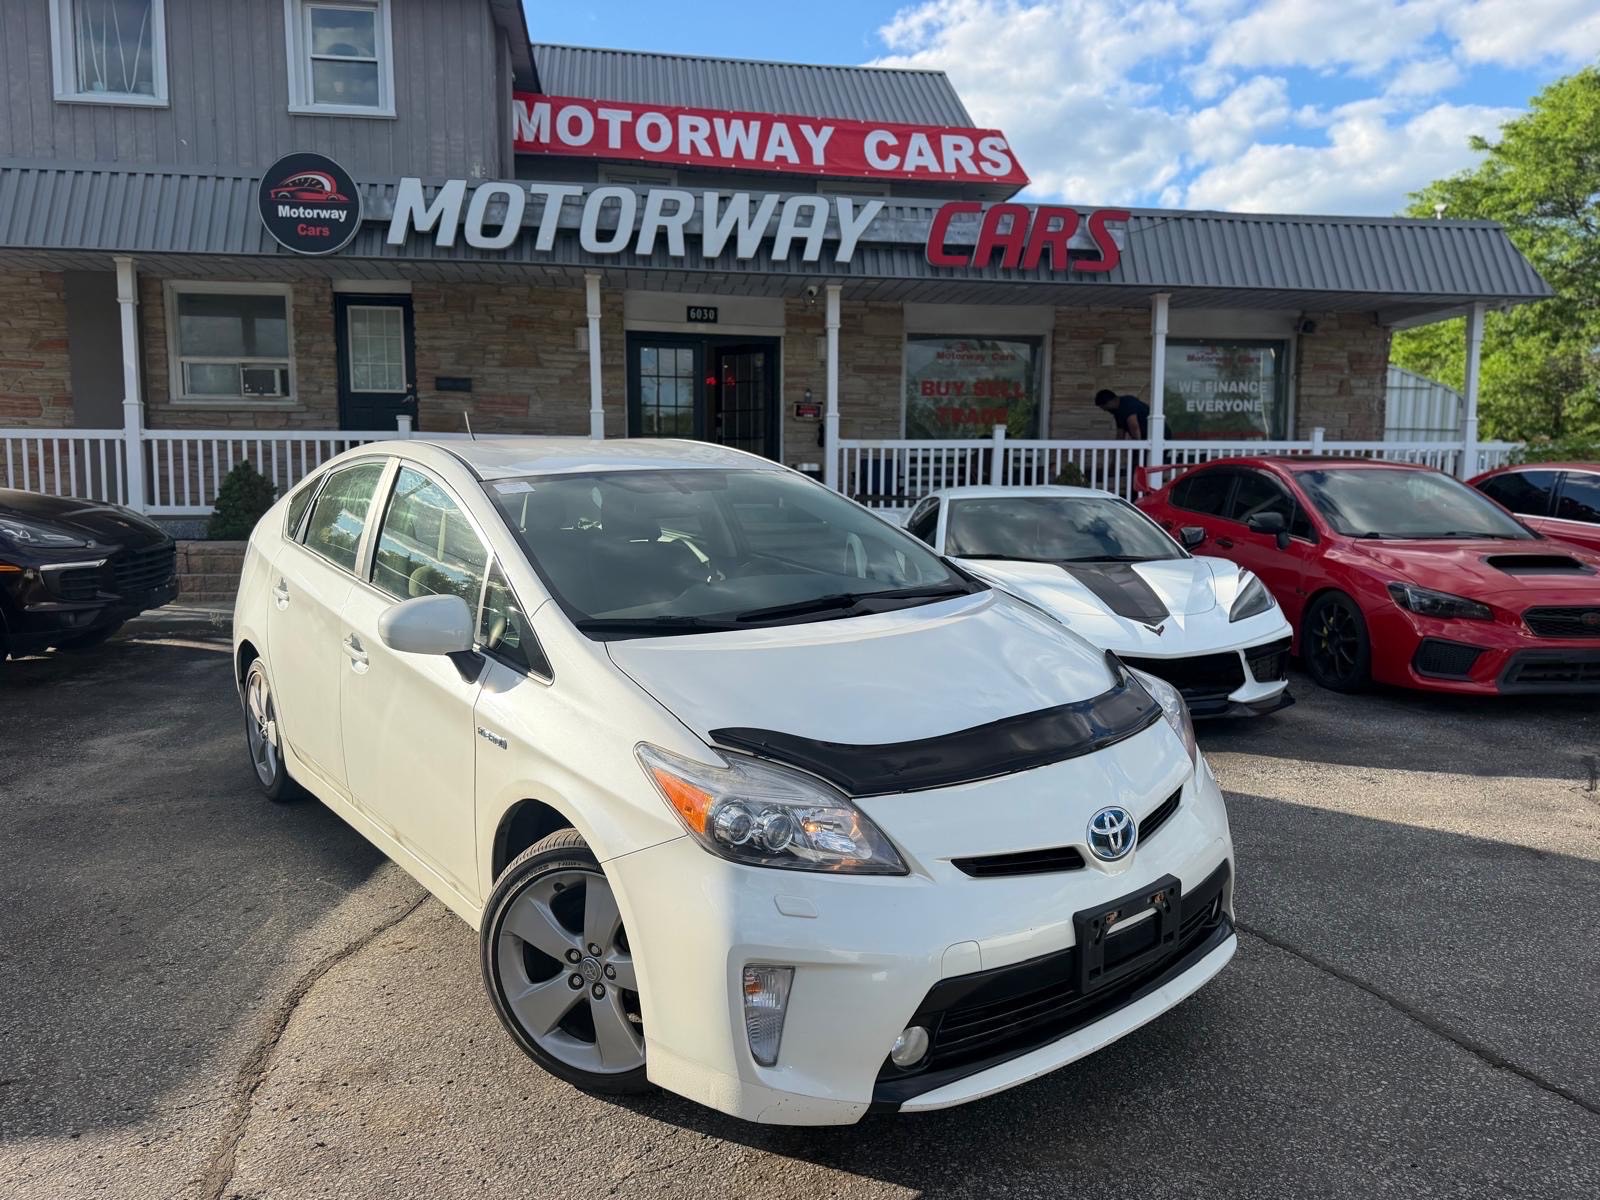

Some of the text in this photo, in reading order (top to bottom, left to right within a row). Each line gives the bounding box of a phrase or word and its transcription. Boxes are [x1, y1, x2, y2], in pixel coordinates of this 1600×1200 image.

[512, 101, 1013, 176] MOTORWAY CARS
[277, 205, 347, 222] Motorway
[297, 224, 330, 236] Cars
[386, 176, 1132, 272] MOTORWAY CARS
[690, 308, 715, 320] 6030
[936, 351, 985, 362] Motorway
[921, 380, 1024, 398] BUY SELL
[1178, 381, 1267, 393] WE FINANCE
[1186, 400, 1263, 412] EVERYONE
